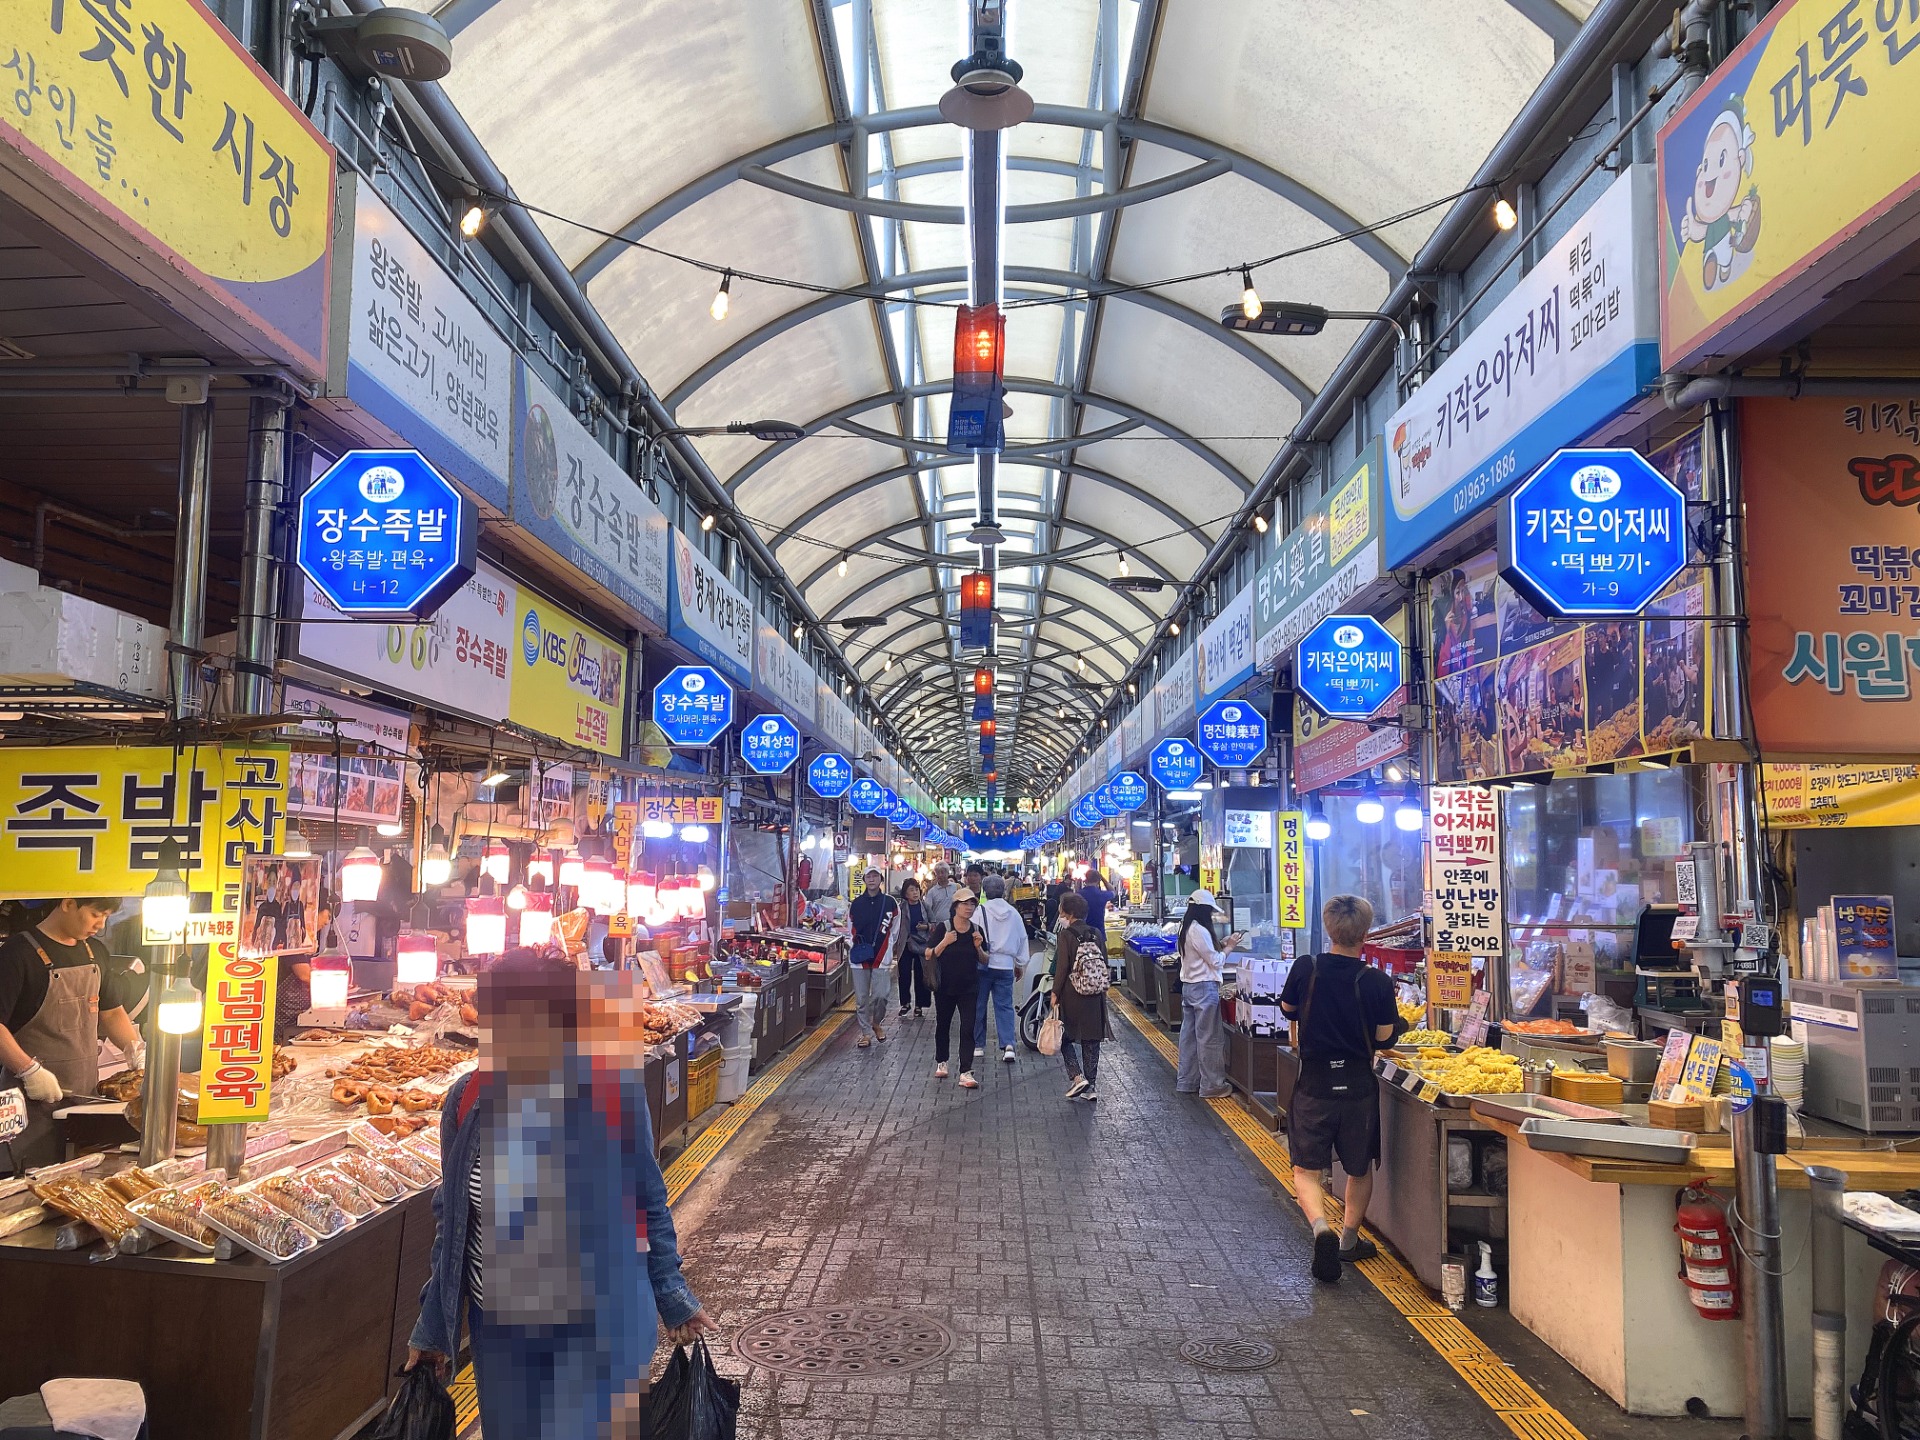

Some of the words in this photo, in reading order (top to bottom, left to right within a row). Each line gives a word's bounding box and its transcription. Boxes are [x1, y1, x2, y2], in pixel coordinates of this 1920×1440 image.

[50, 0, 193, 143] 뜻한
[213, 102, 300, 237] 시장
[1569, 232, 1592, 273] 튀김
[1570, 263, 1606, 308] 떡볶이
[369, 238, 426, 332] 왕족발,
[432, 306, 488, 390] 고사머리
[1571, 287, 1620, 351] 꼬마김밥
[368, 299, 440, 401] 삶은고기,
[446, 372, 499, 449] 양념편육
[1437, 285, 1560, 449] 키작은아저씨
[1454, 449, 1516, 515] 02)963-1886
[315, 508, 448, 543] 장수족발
[566, 453, 640, 576] 장수족발
[1526, 507, 1670, 543] 키작은아저씨
[1561, 553, 1643, 575] 떡뽀끼
[352, 579, 399, 595] 나-12
[1582, 581, 1620, 597] 가-9
[694, 563, 734, 639] 형제상회
[456, 626, 508, 680] 장수족발
[543, 628, 567, 668] KBS
[1207, 630, 1226, 682] 연서네
[1307, 651, 1393, 673] 키작은아저씨
[1782, 632, 1920, 698] 시원
[771, 646, 799, 703] 하나축산
[1331, 678, 1374, 692] 떡뽀끼
[661, 694, 726, 711] 장수족발
[1340, 696, 1364, 705] 가-9
[382, 725, 404, 740] 장수족발
[575, 702, 609, 747] 노포족발
[680, 729, 704, 737] 나-12
[747, 735, 795, 750] 형제상회
[1157, 756, 1196, 769] 연서네
[812, 769, 849, 779] 하나축산
[1810, 776, 1831, 791] 오징어
[645, 801, 717, 820] 장수족발
[1433, 790, 1494, 812] 키작은
[1772, 795, 1802, 809] 7,000원
[1810, 795, 1839, 809] 고추튀김
[5, 772, 217, 875] 족발
[1434, 813, 1496, 831] 아저씨
[224, 756, 284, 912] 고사머
[617, 809, 633, 861] 고사머리
[1435, 834, 1495, 856] 떡뽀끼
[1283, 818, 1301, 922] 명진한약초
[1444, 869, 1489, 885] 안쪽에
[1436, 888, 1499, 911] 냉난방
[208, 921, 234, 936] 녹화중
[882, 912, 893, 933] FILA
[1445, 912, 1490, 928] 잘되는
[1436, 930, 1499, 952] 홀있어요
[1436, 974, 1467, 987] 밀키트
[1440, 989, 1463, 1001] 판매
[1695, 1042, 1720, 1064] 시원한
[1686, 1061, 1716, 1087] 냉모밀
